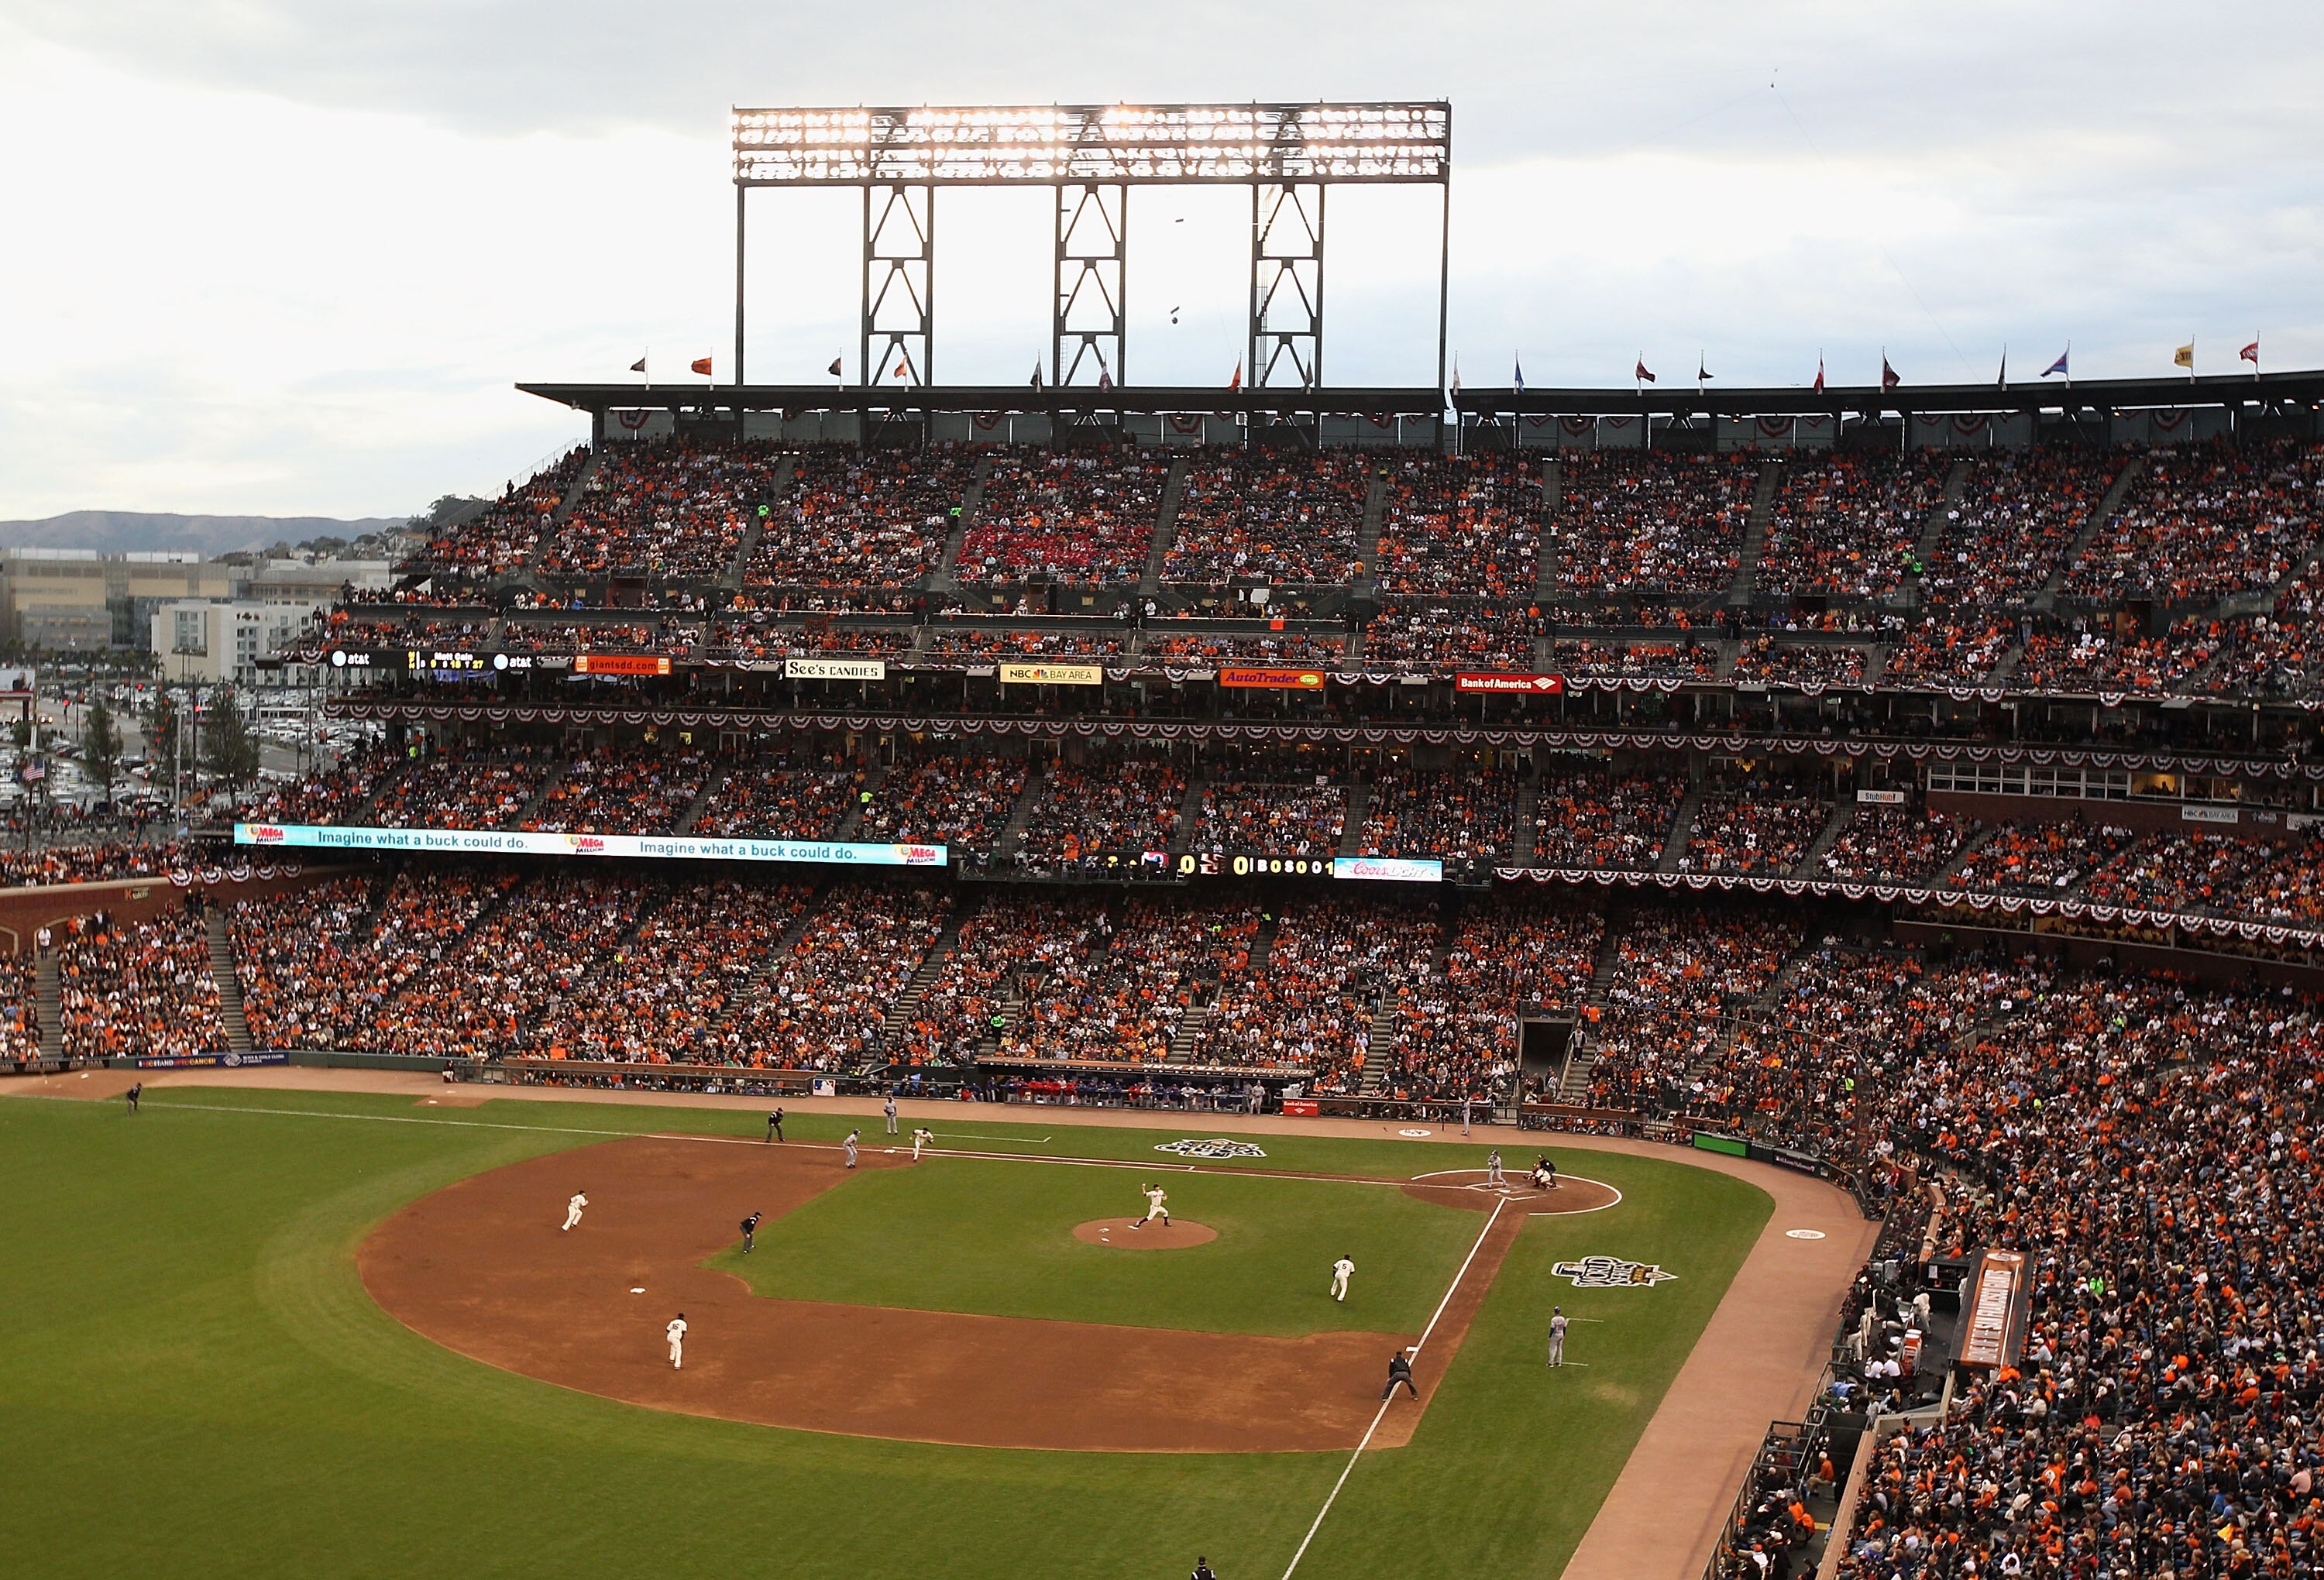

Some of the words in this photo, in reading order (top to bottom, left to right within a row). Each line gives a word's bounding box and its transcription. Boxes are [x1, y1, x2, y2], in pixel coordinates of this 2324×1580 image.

[348, 653, 370, 665] at&t
[435, 652, 453, 661] Matt
[509, 656, 532, 668] at&t
[473, 659, 484, 668] 27
[590, 661, 656, 670] giantsdd.com
[789, 662, 825, 675] See's
[830, 667, 878, 677] CANDIES
[1010, 669, 1031, 678] NBC
[1050, 671, 1067, 679] BAY
[1461, 678, 1484, 688] Bank
[1484, 678, 1494, 688] of
[1494, 679, 1532, 689] America
[1865, 792, 1896, 802] StubHub!
[259, 827, 284, 837] MEGA
[318, 831, 372, 846] Imagine
[376, 833, 409, 845] what
[426, 834, 459, 846] buck
[464, 836, 502, 847] could
[507, 837, 528, 848] do.
[578, 837, 603, 847] MEGA
[641, 841, 695, 856] Imagine
[700, 843, 734, 855] what
[738, 847, 746, 855] a
[751, 845, 786, 857] buck
[791, 847, 830, 858] could
[835, 847, 858, 859] do.
[909, 847, 935, 857] MEGA
[1180, 855, 1195, 874] 0
[1233, 856, 1249, 875] 0
[1353, 860, 1387, 875] Coors
[1387, 867, 1425, 877] LIGHT
[1576, 1257, 1617, 1286] WORLD
